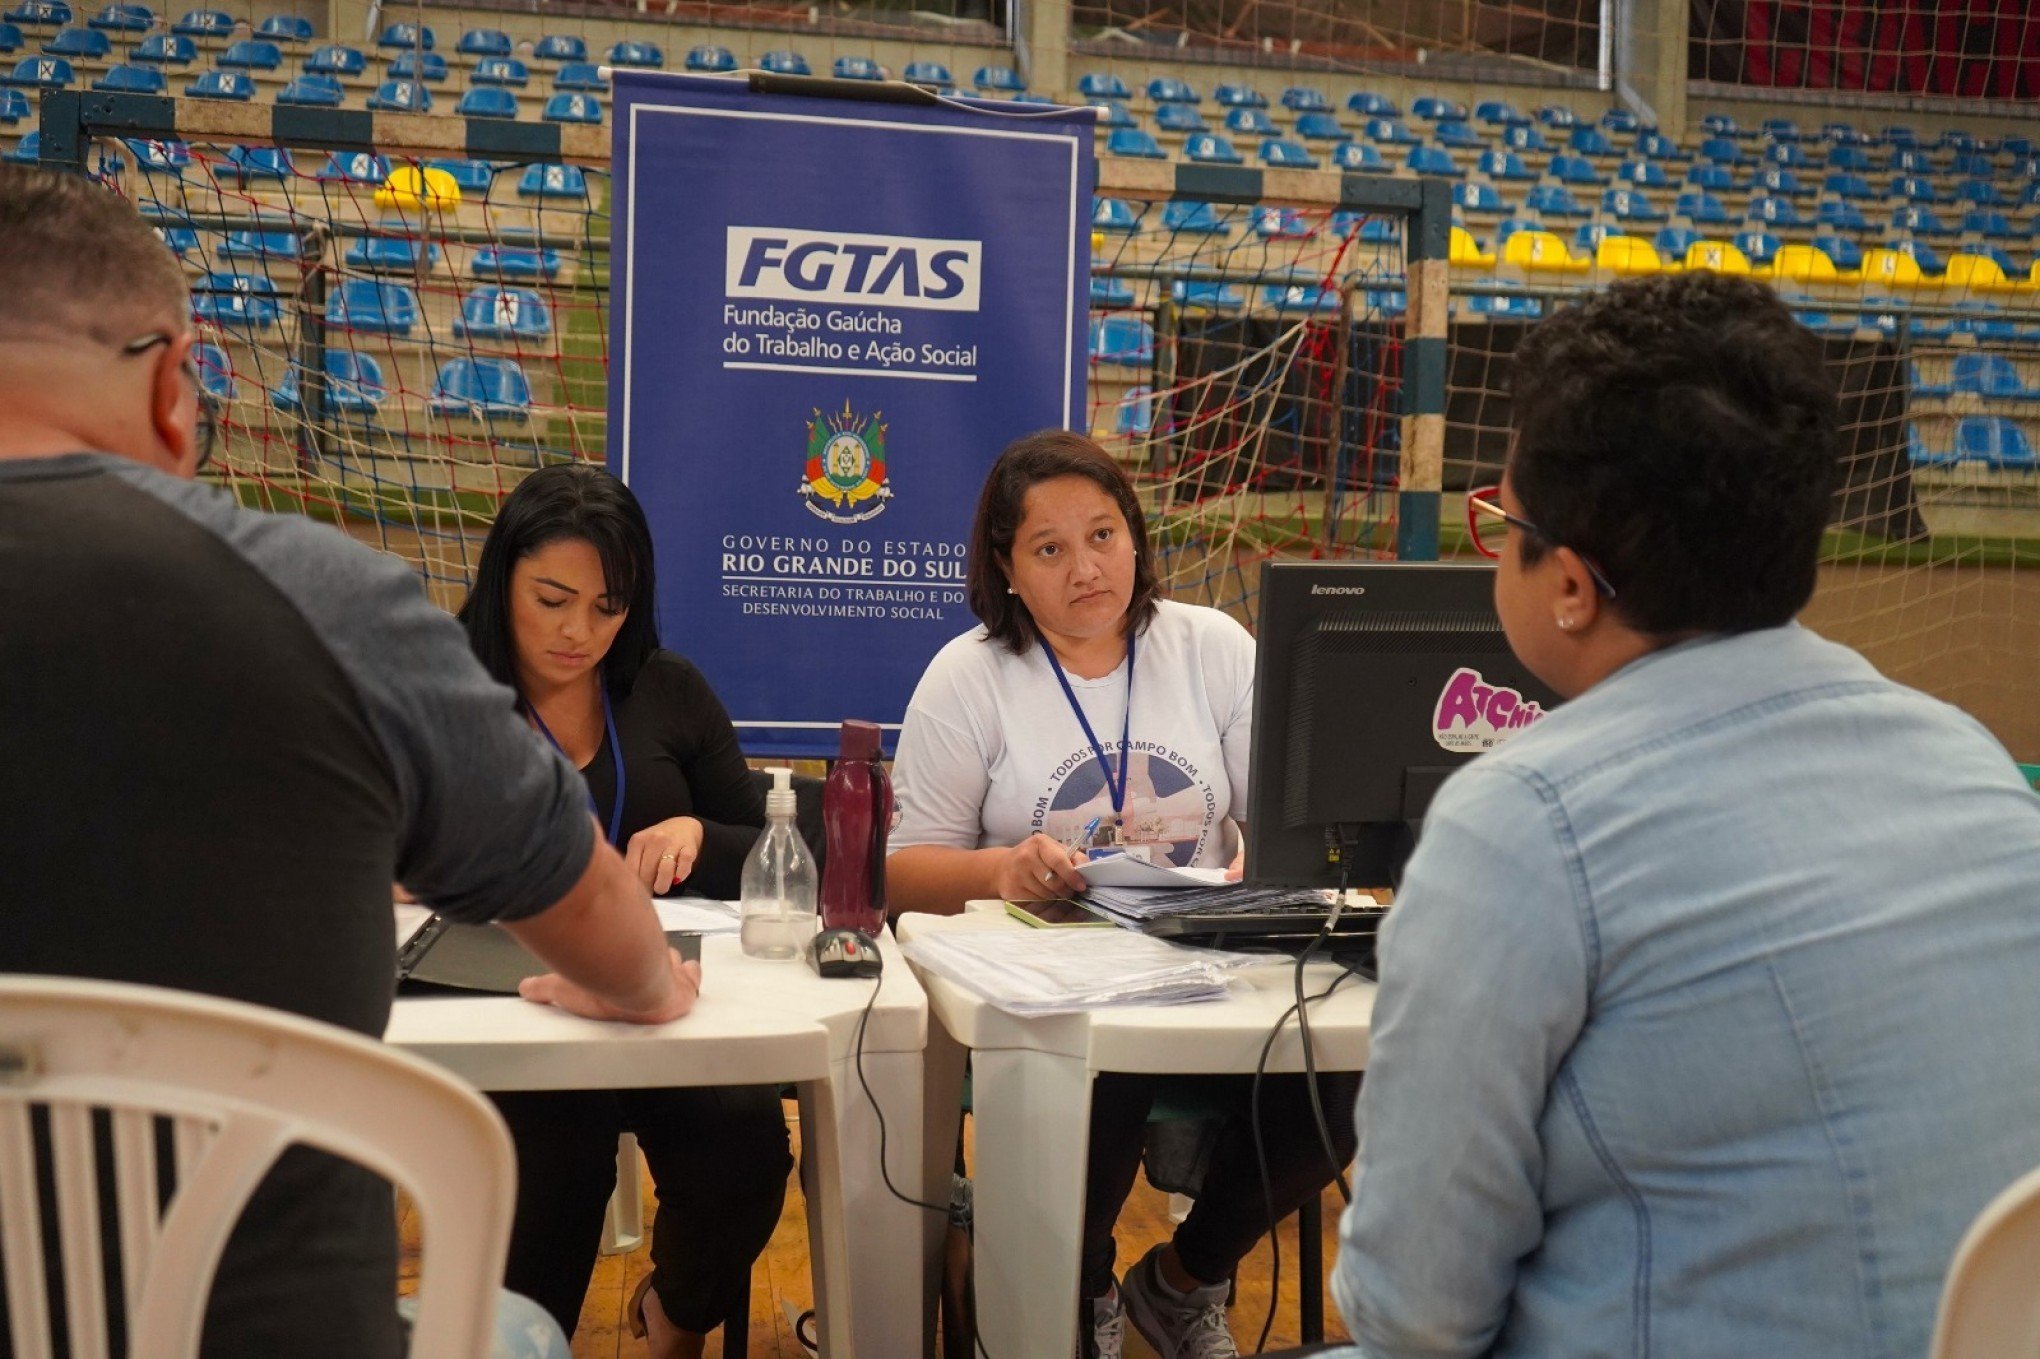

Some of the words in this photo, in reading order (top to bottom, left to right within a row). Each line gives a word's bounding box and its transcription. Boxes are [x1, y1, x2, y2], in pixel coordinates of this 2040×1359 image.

[738, 237, 969, 299] FGTAS
[723, 304, 821, 333] Fundação
[826, 310, 902, 334] Gaúcha
[723, 332, 750, 354] do
[756, 334, 842, 359] Trabalho
[848, 345, 859, 360] e
[866, 341, 915, 367] Ação
[921, 343, 977, 366] Social
[722, 535, 829, 553] GOVERNO
[842, 541, 871, 554] DO
[885, 541, 967, 557] ESTADO
[722, 554, 765, 572] RIO
[773, 556, 874, 576] GRANDE
[883, 559, 917, 578] DO
[925, 561, 967, 579] SUL
[722, 585, 813, 599] SECRETARIA
[819, 588, 841, 600] DO
[846, 588, 925, 602] TRABALHO
[930, 591, 937, 603] E
[943, 592, 965, 604] DO
[1311, 584, 1365, 595] lenovo
[742, 602, 886, 618] DESENVOLVIMENTO
[890, 607, 944, 620] SOCIAL
[1050, 749, 1087, 781] TODOS
[1168, 750, 1198, 777] BOM
[1031, 797, 1050, 827] BOM
[1203, 784, 1216, 827] TODOS
